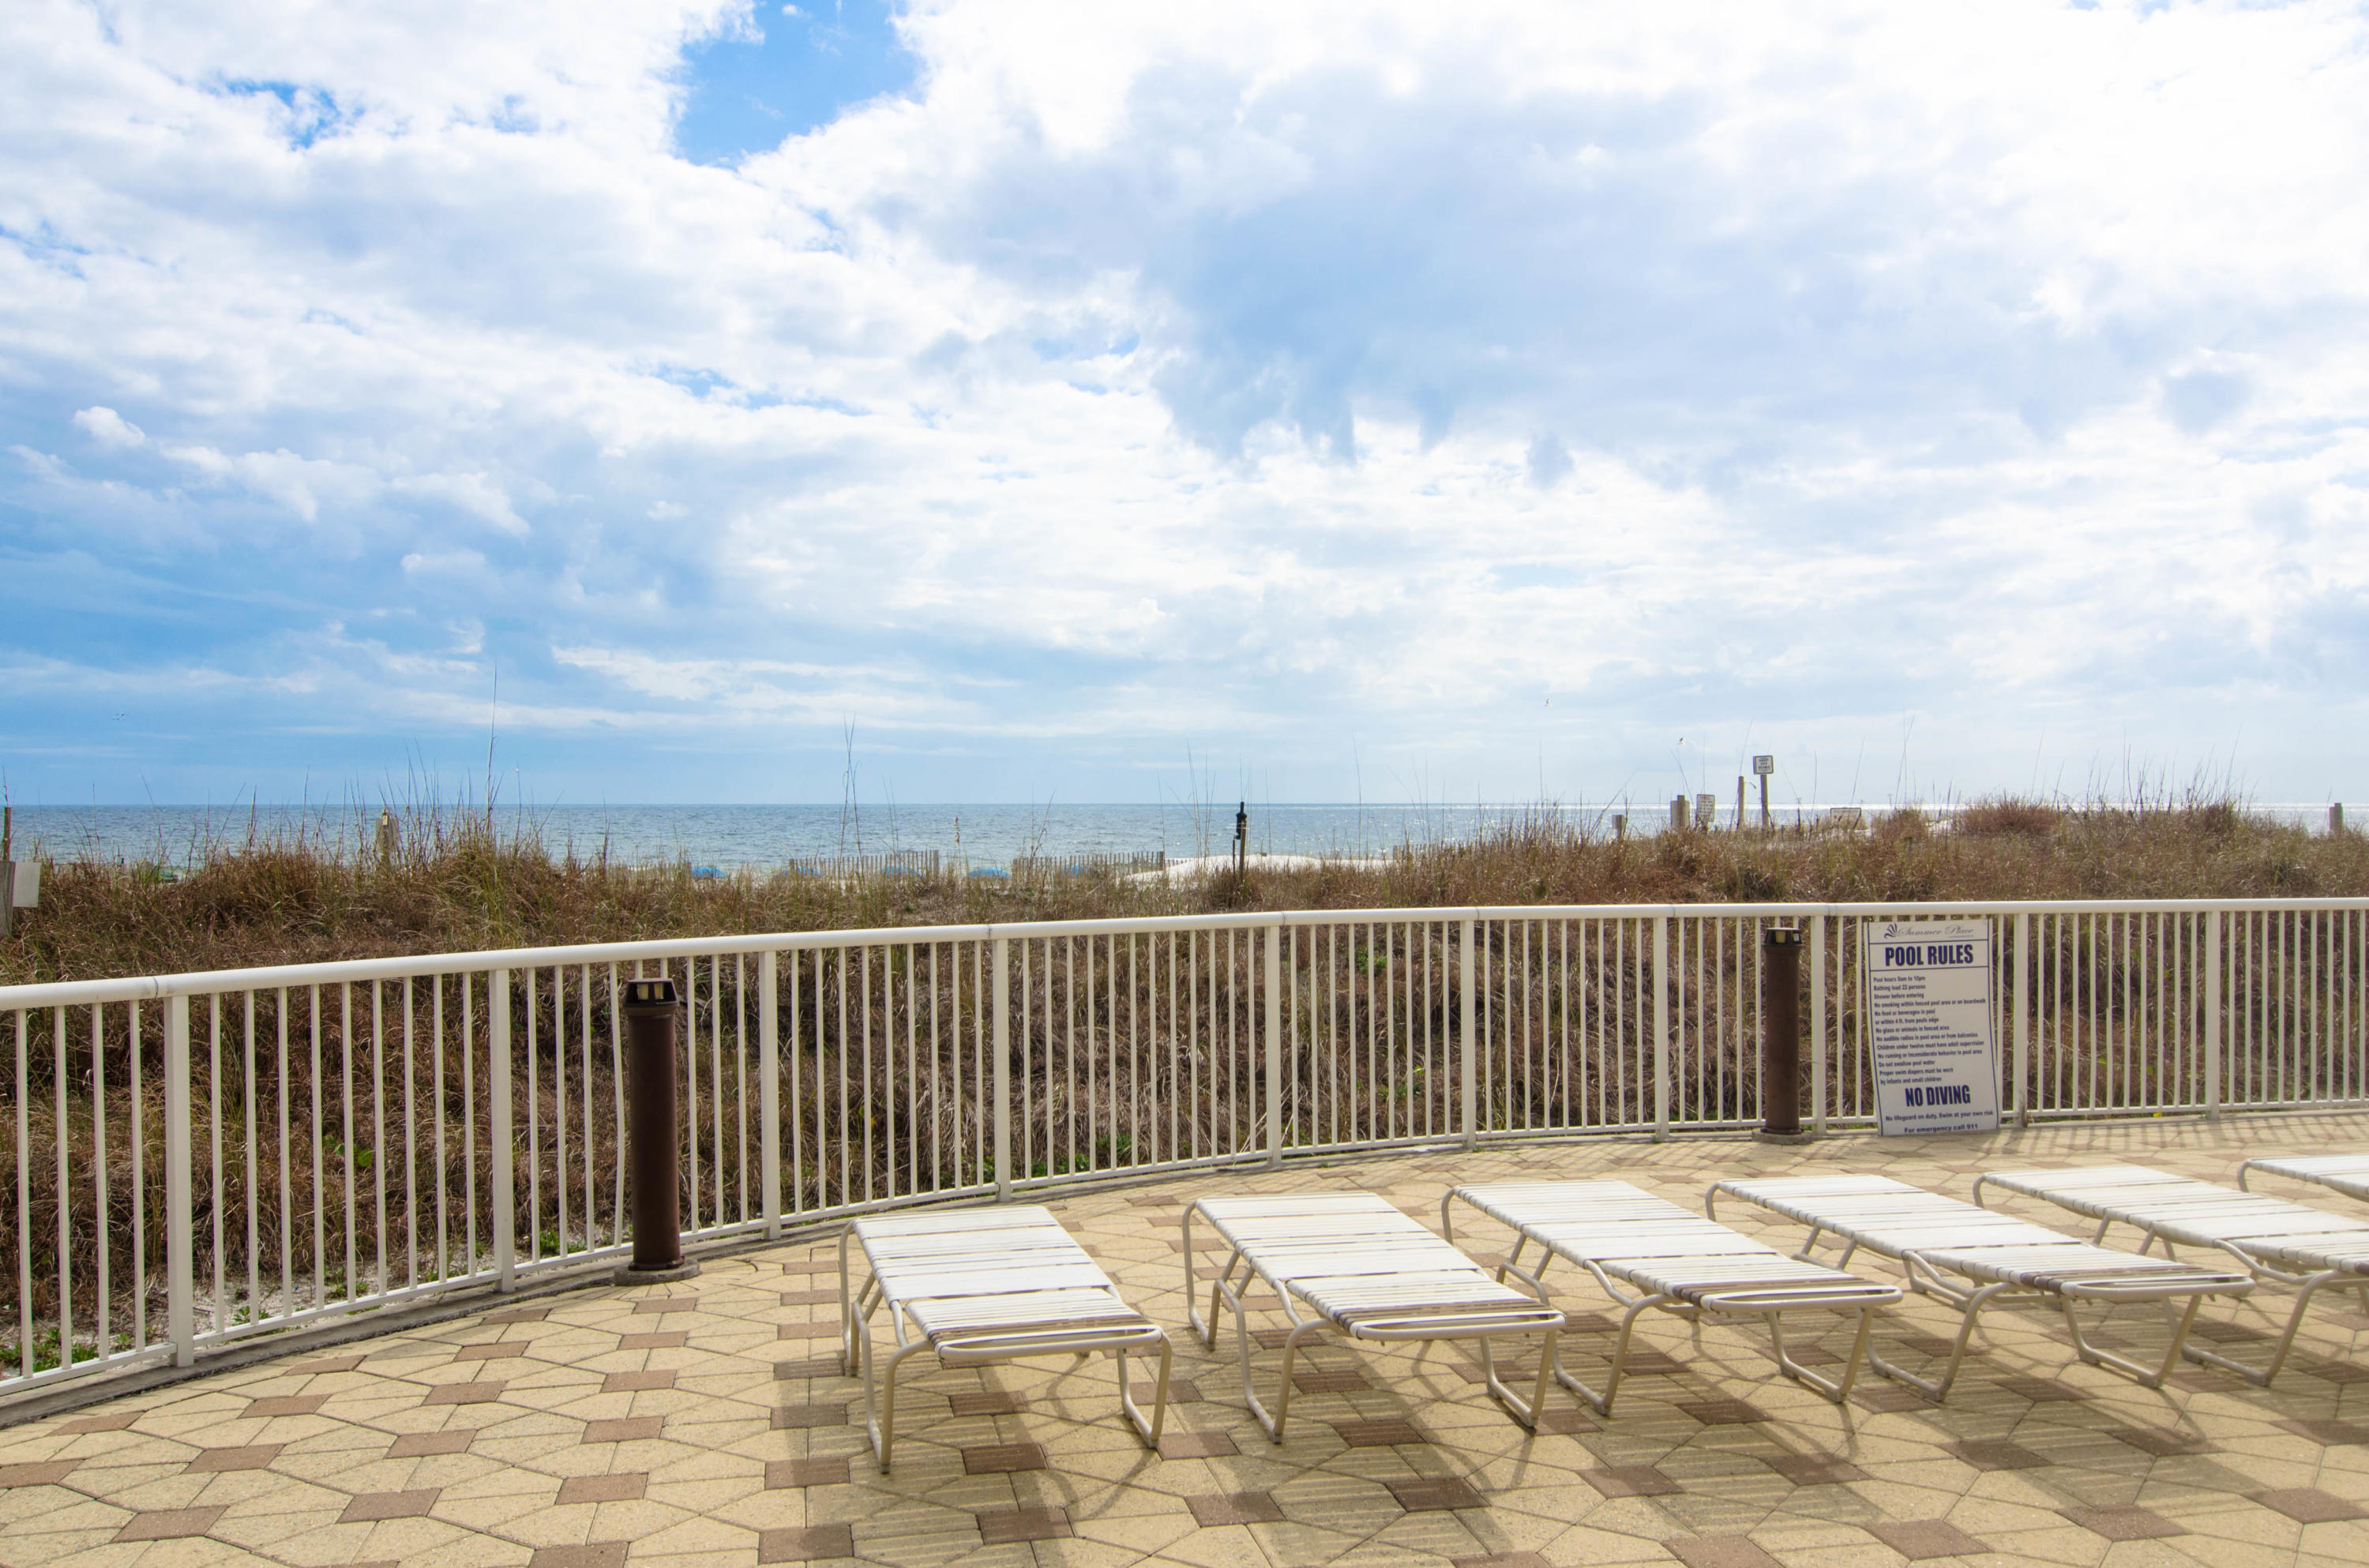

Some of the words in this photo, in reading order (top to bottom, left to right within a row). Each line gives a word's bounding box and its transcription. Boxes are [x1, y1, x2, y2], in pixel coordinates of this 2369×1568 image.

[1898, 927, 1941, 936] Summer
[1945, 925, 1973, 935] Place
[1885, 947, 1924, 966] POOL
[1928, 944, 1973, 965] RULES
[1905, 1087, 1923, 1107] NO
[1926, 1085, 1970, 1105] DIVING
